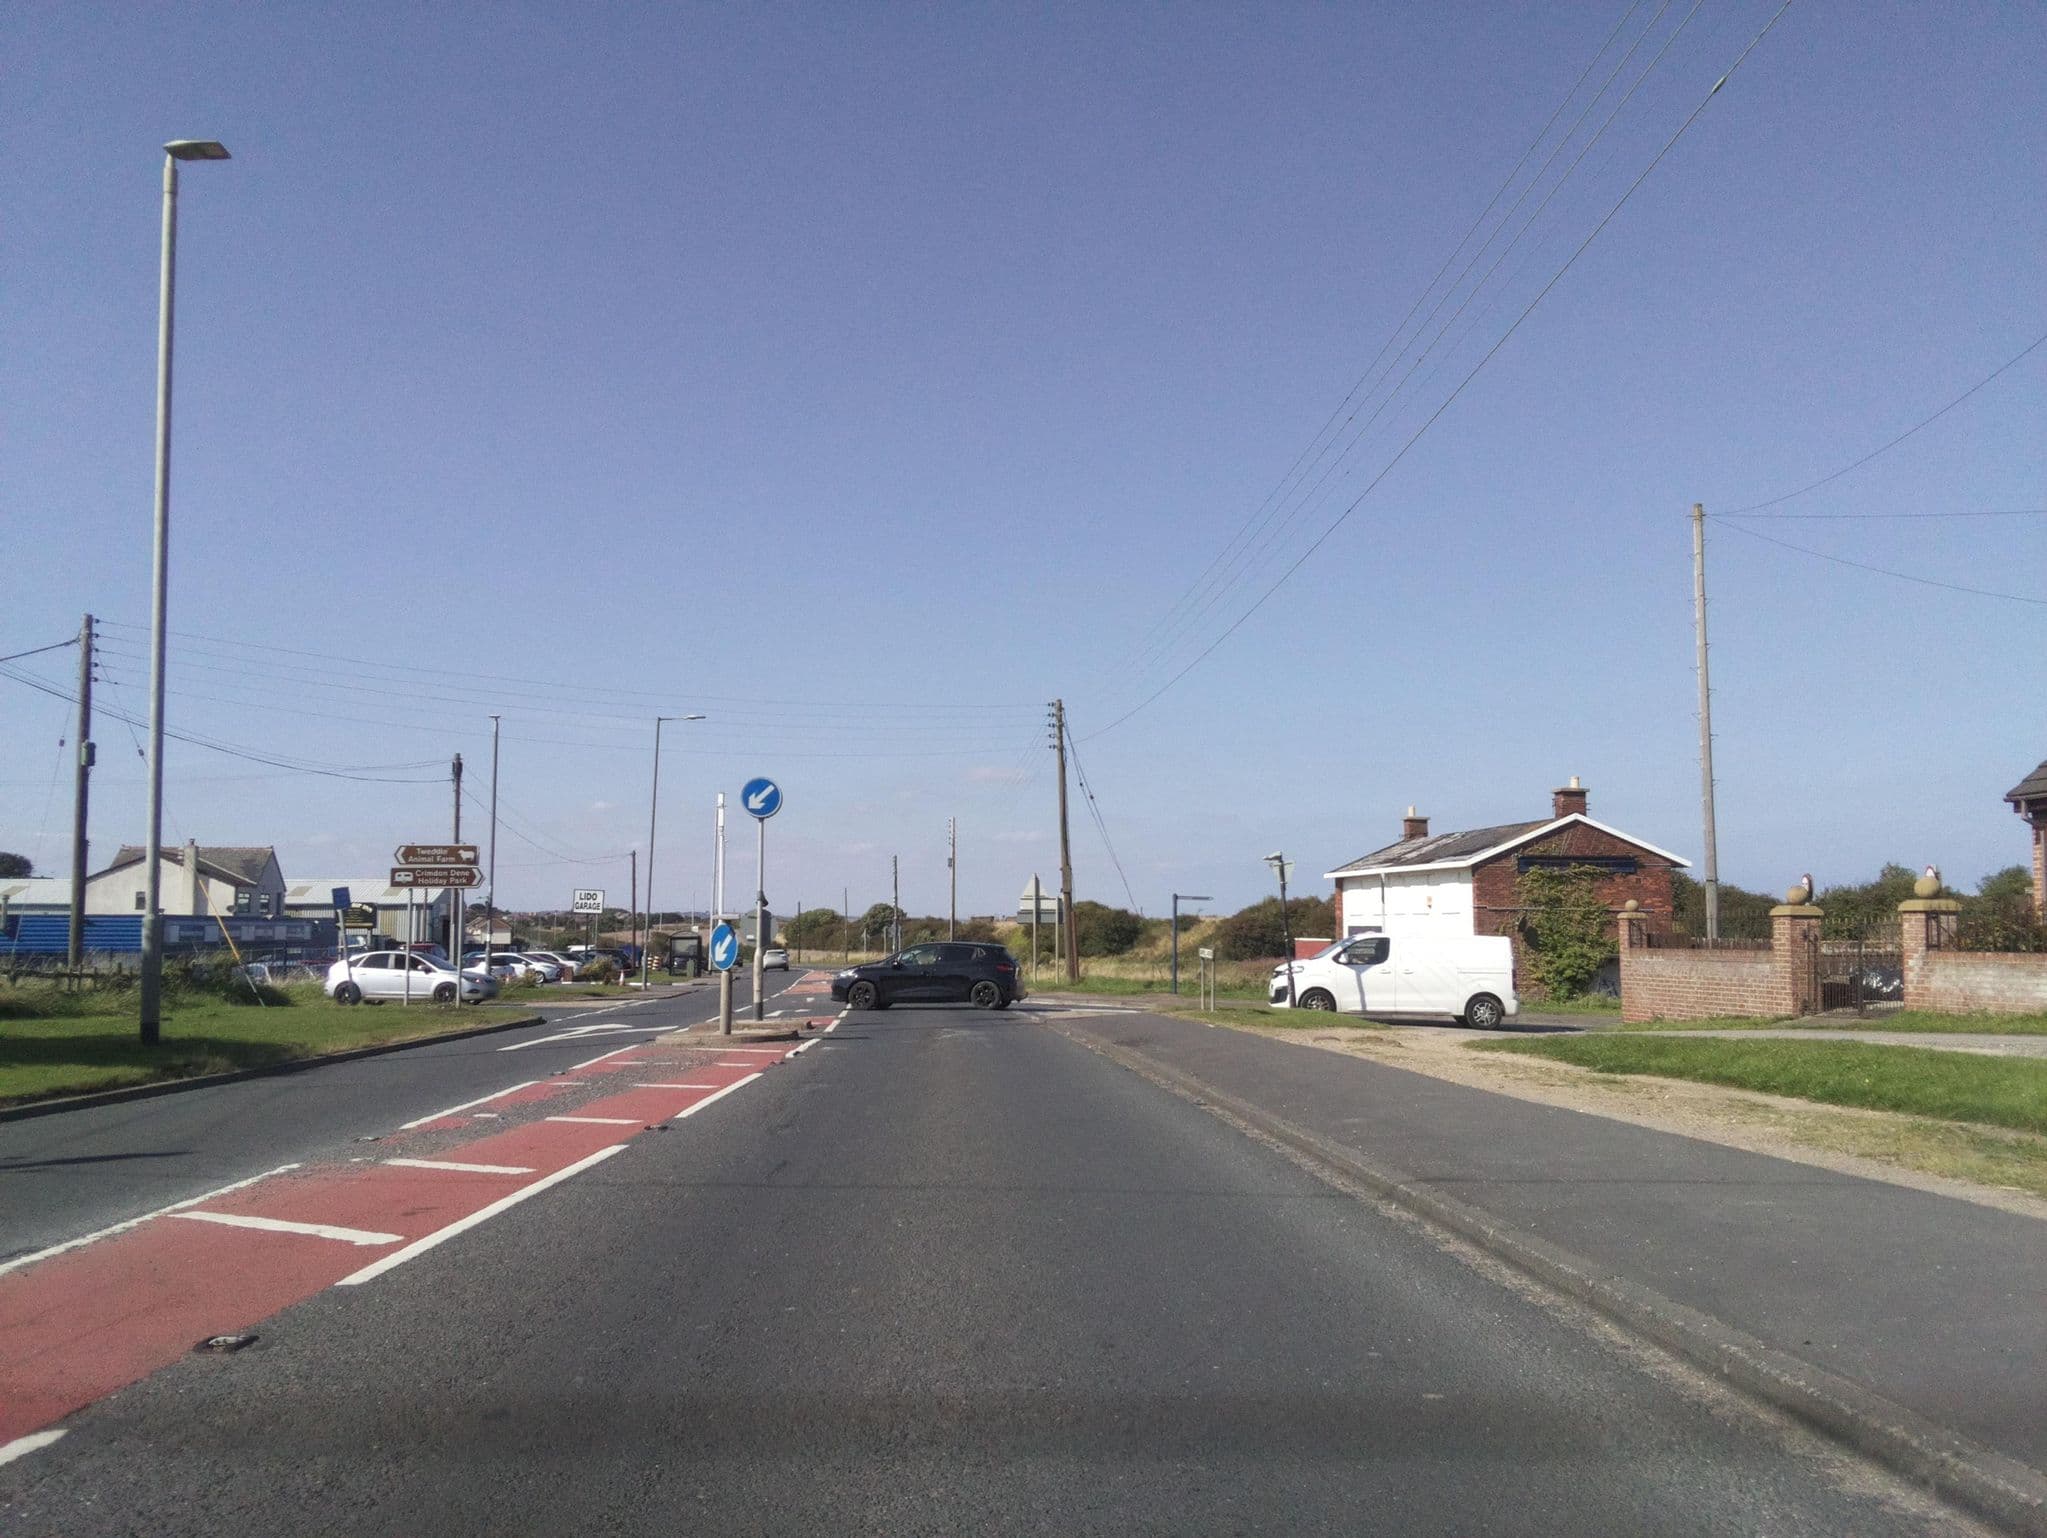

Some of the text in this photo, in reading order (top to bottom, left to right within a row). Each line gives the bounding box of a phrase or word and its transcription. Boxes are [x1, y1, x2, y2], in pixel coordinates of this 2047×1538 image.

[415, 869, 470, 877] Crimdon Dene
[418, 877, 448, 885] Holiday
[579, 892, 598, 901] LIDO
[574, 901, 601, 910] GARAGE
